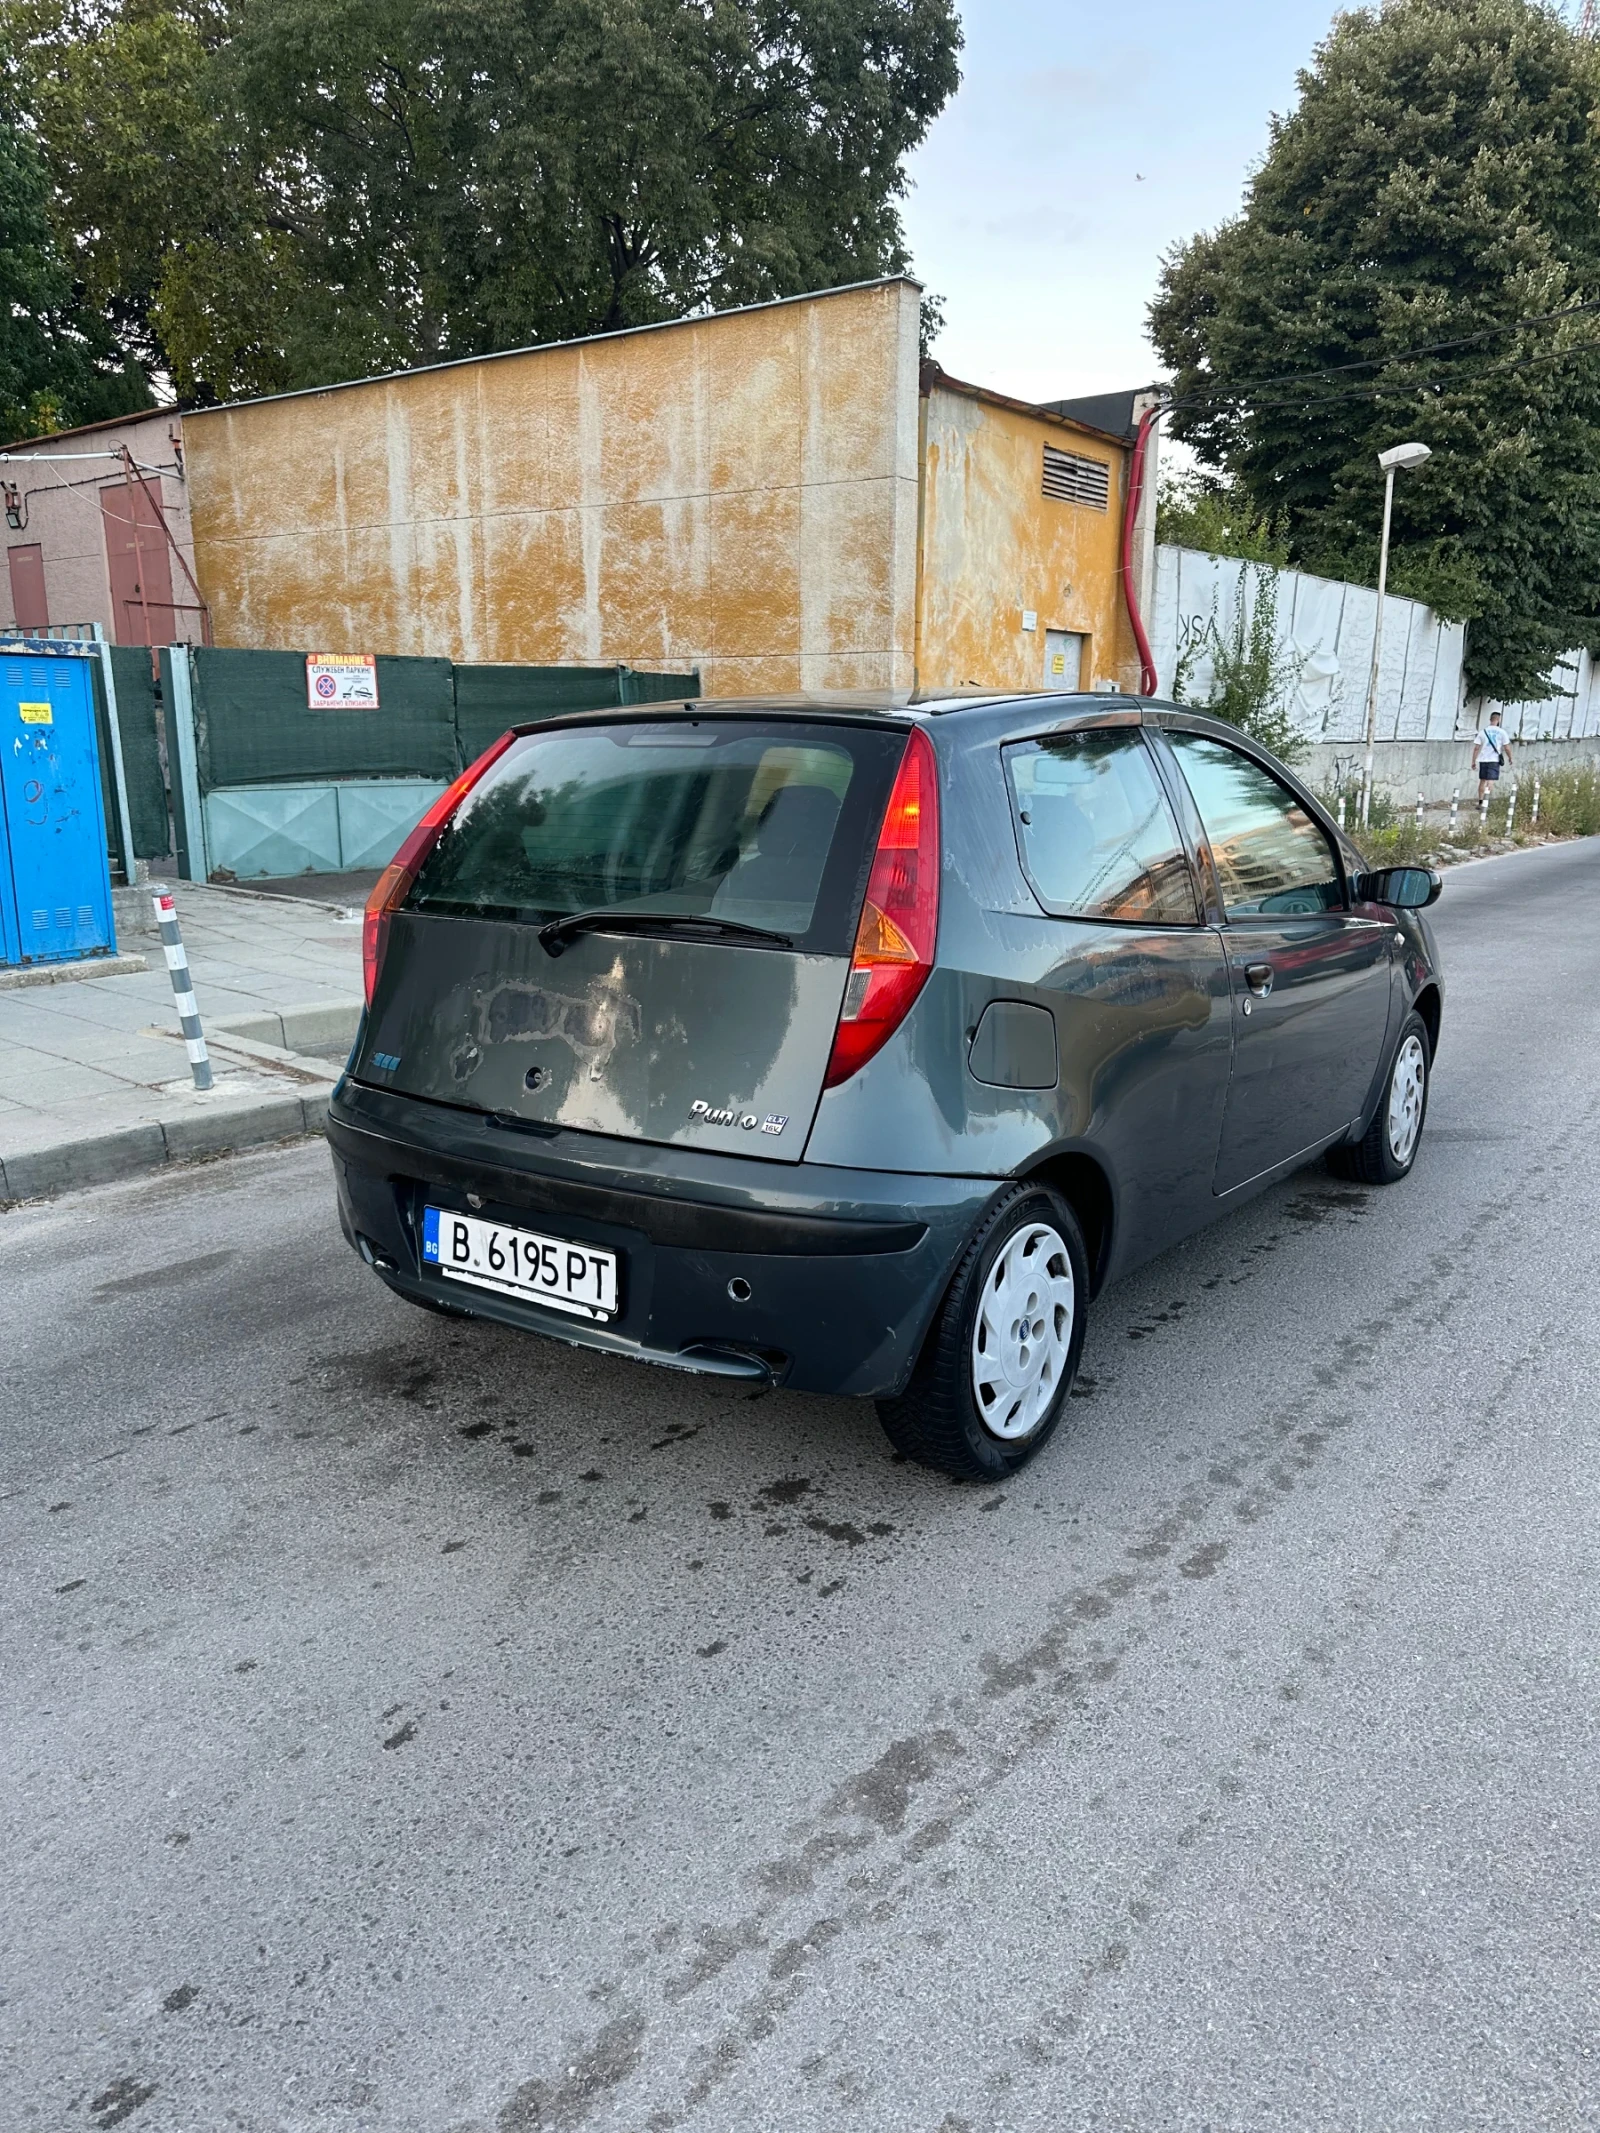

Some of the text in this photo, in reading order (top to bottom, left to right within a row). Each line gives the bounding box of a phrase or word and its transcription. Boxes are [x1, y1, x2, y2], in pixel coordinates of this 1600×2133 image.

[317, 655, 365, 665] ВНИМАНИЕ
[688, 1099, 758, 1130] Punto
[425, 1241, 438, 1254] BG
